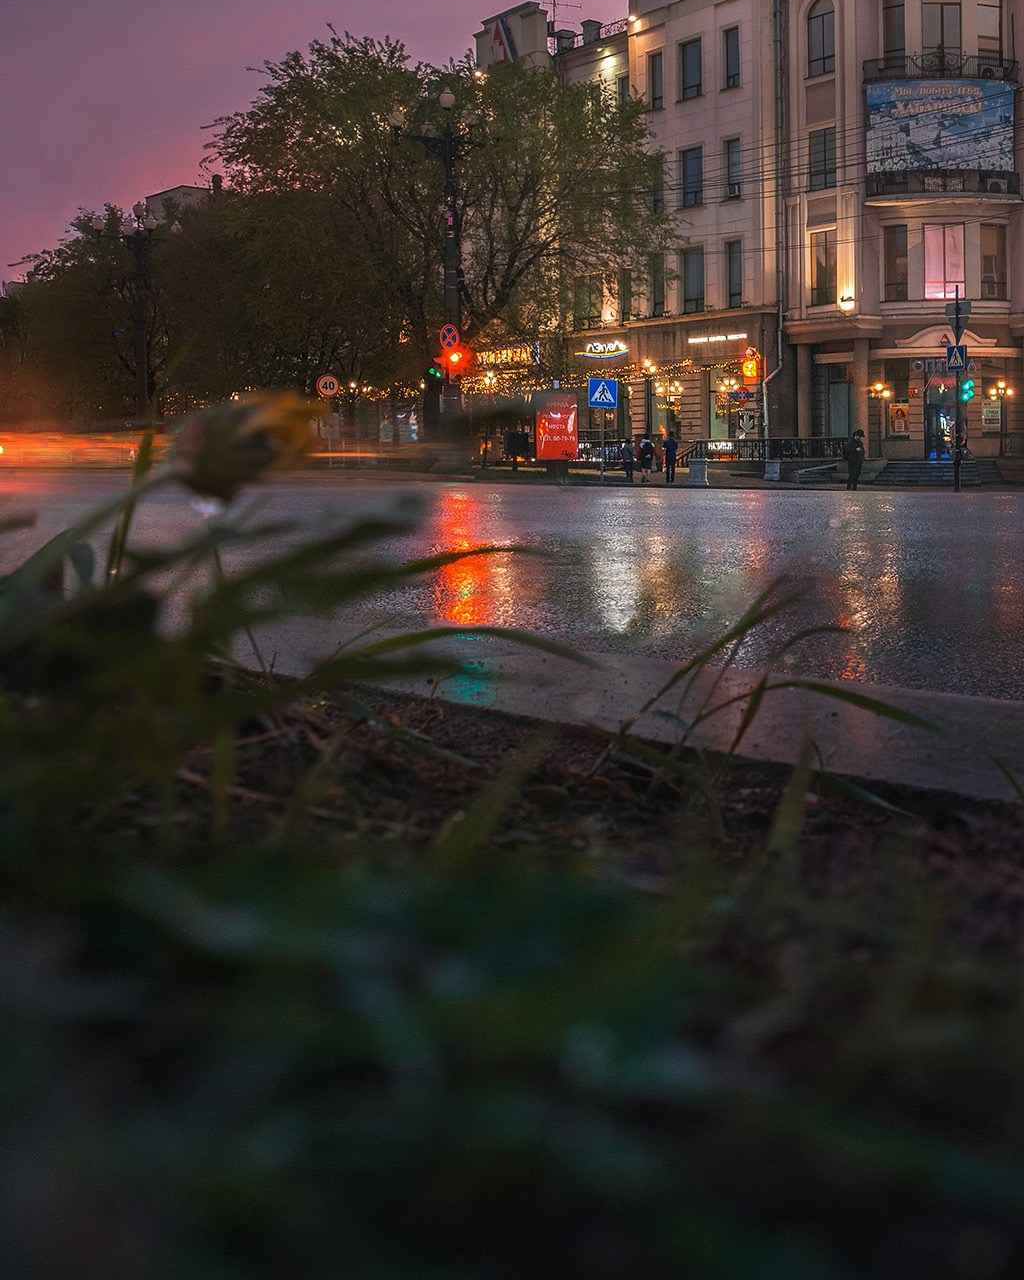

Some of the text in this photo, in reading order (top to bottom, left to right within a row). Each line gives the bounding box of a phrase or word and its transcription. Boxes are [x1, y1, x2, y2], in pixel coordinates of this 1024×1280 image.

[916, 86, 953, 96] ЛЮБИМ
[912, 359, 977, 373] ОПТА
[321, 381, 335, 391] 40
